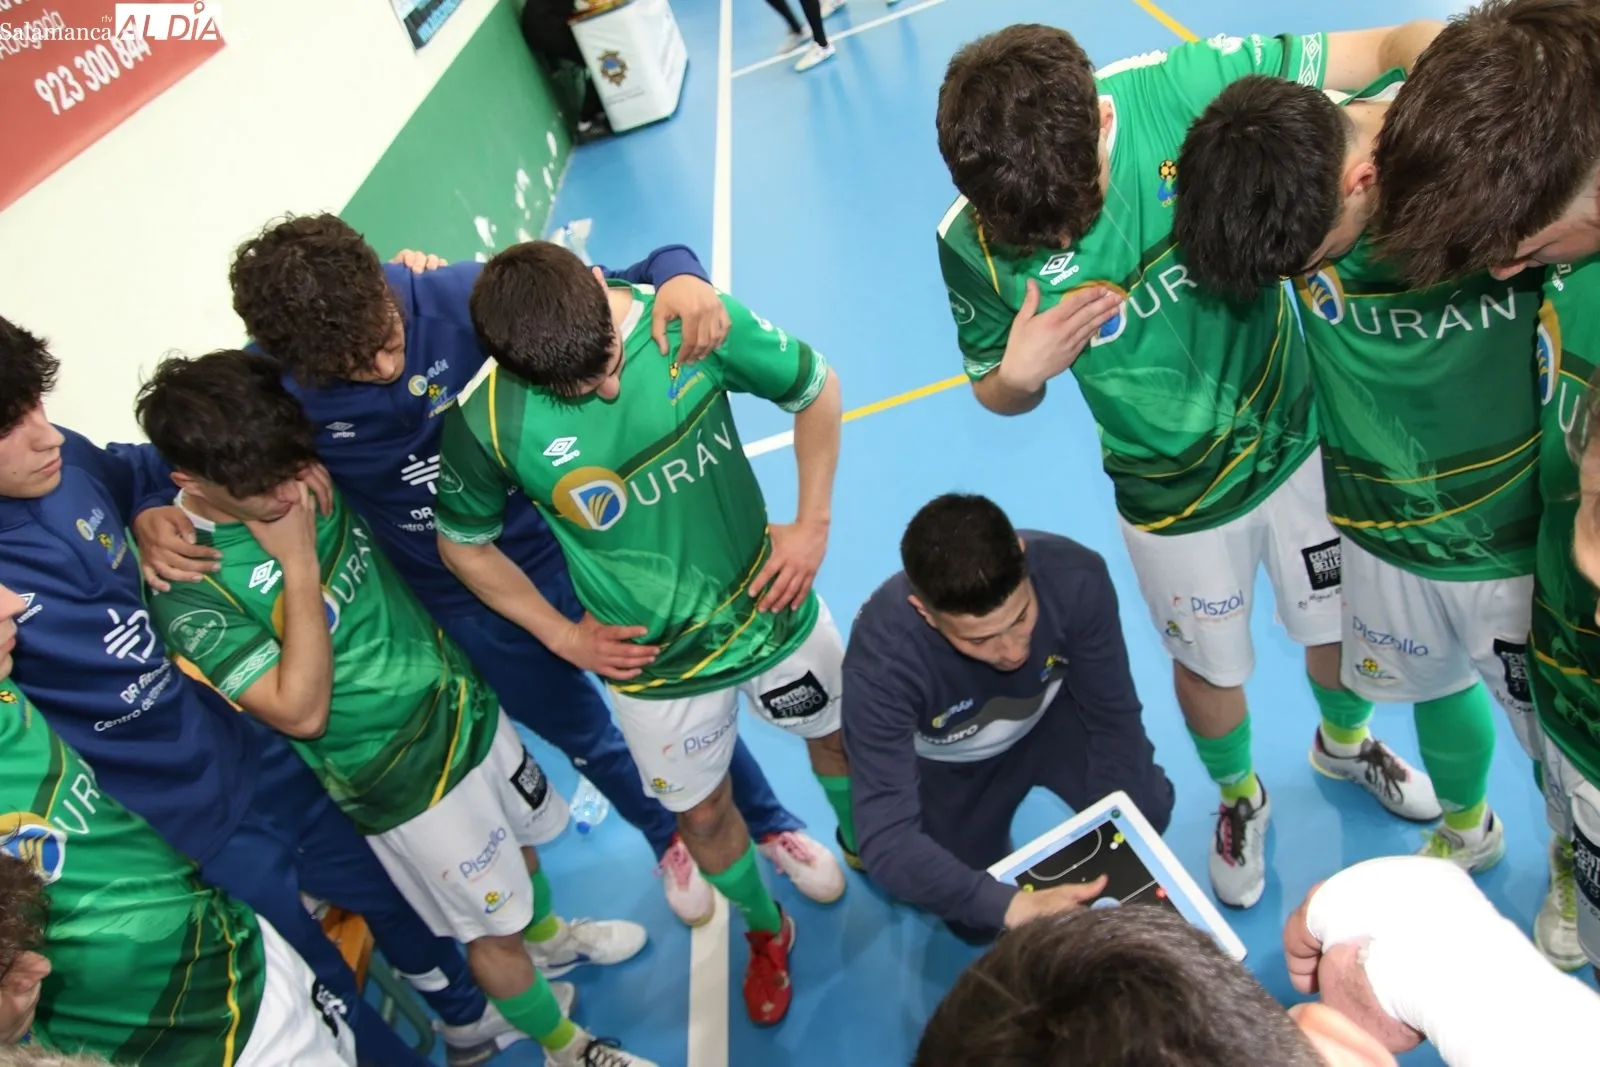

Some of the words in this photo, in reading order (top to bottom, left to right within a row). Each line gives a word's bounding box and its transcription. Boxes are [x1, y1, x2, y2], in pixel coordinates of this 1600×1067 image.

[34, 65, 86, 115] 923
[74, 43, 121, 92] 300
[1050, 264, 1080, 286] umbro
[551, 449, 581, 467] umbro
[410, 506, 434, 521] DR
[120, 683, 140, 704] DR
[93, 708, 142, 732] Centro
